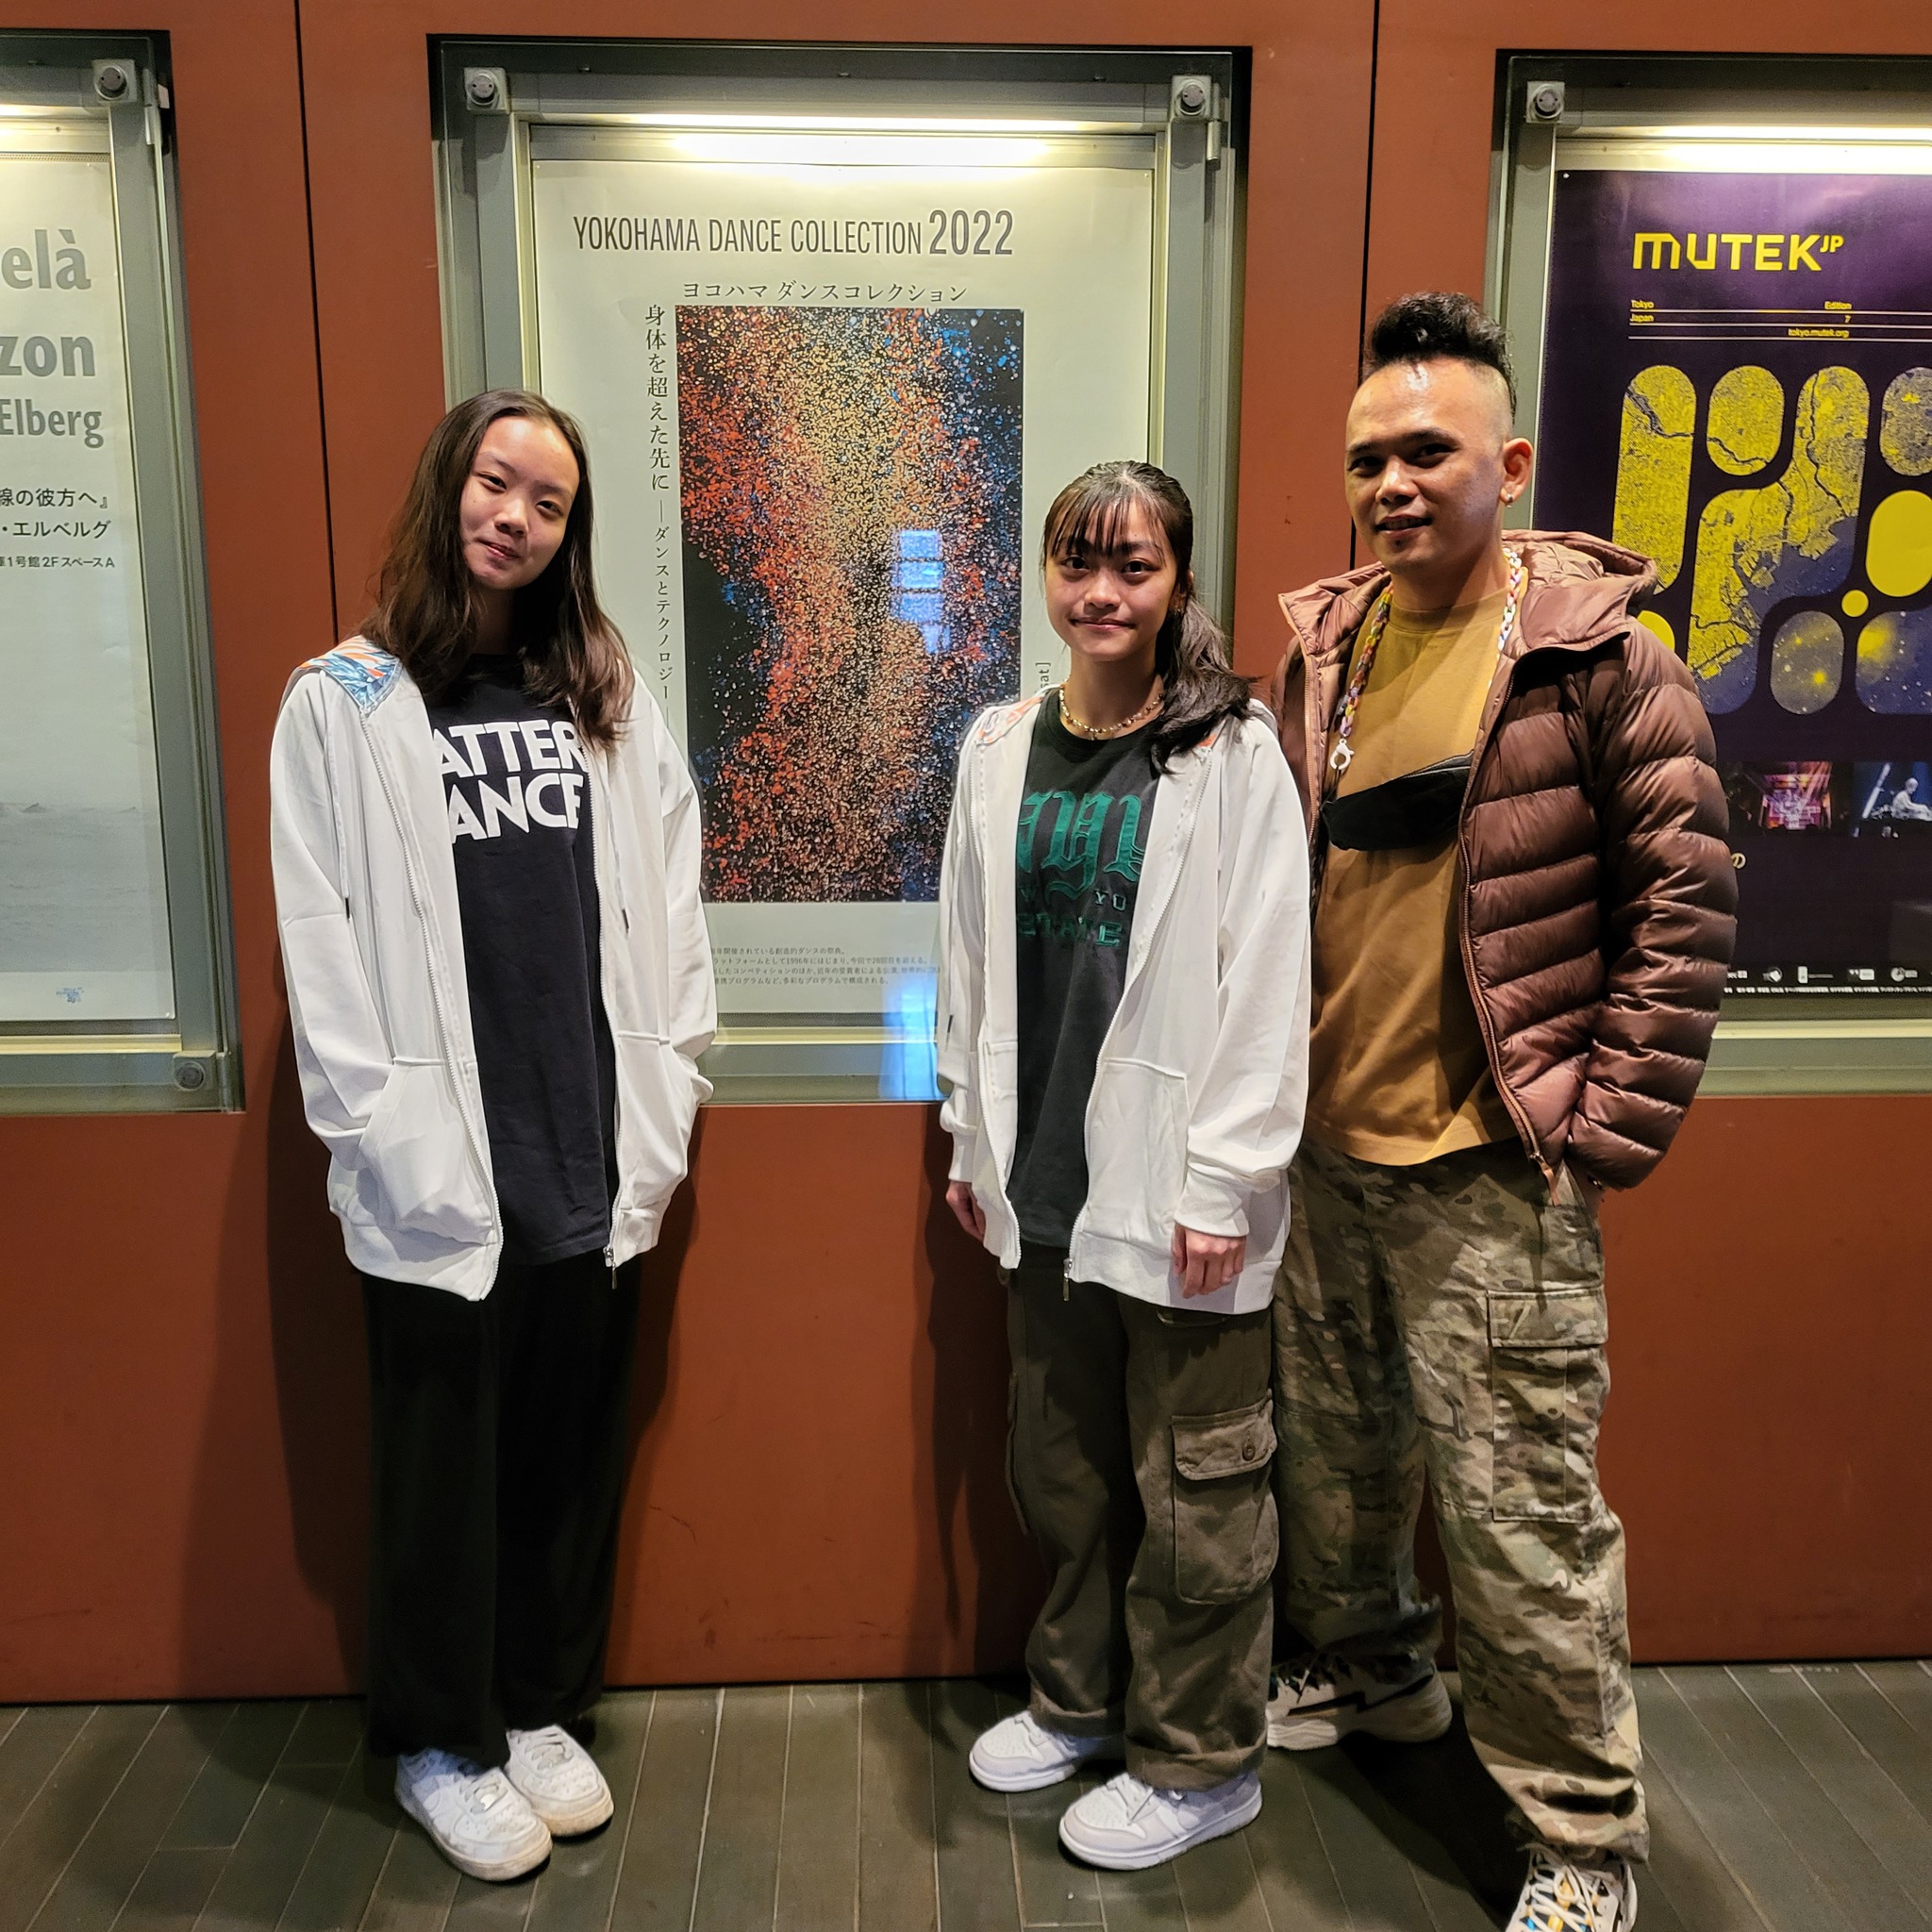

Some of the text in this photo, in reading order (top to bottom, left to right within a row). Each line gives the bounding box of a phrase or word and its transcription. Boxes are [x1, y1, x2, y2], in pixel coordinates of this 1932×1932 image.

[573, 208, 1014, 256] YOKOHAMA DANCE COLLECTION 2022
[1, 229, 91, 290] elà
[684, 280, 968, 302] ヨコハマ ダンスコレクション
[1630, 299, 1655, 309] Tokyo
[1824, 300, 1853, 310] Edition
[1629, 313, 1655, 323] Japan
[1844, 314, 1852, 324] 7
[1788, 327, 1850, 339] tokyo.mutek.org
[644, 304, 671, 491] 身体を超えた先に
[0, 398, 105, 449] Elberg
[433, 719, 590, 778] ATTER
